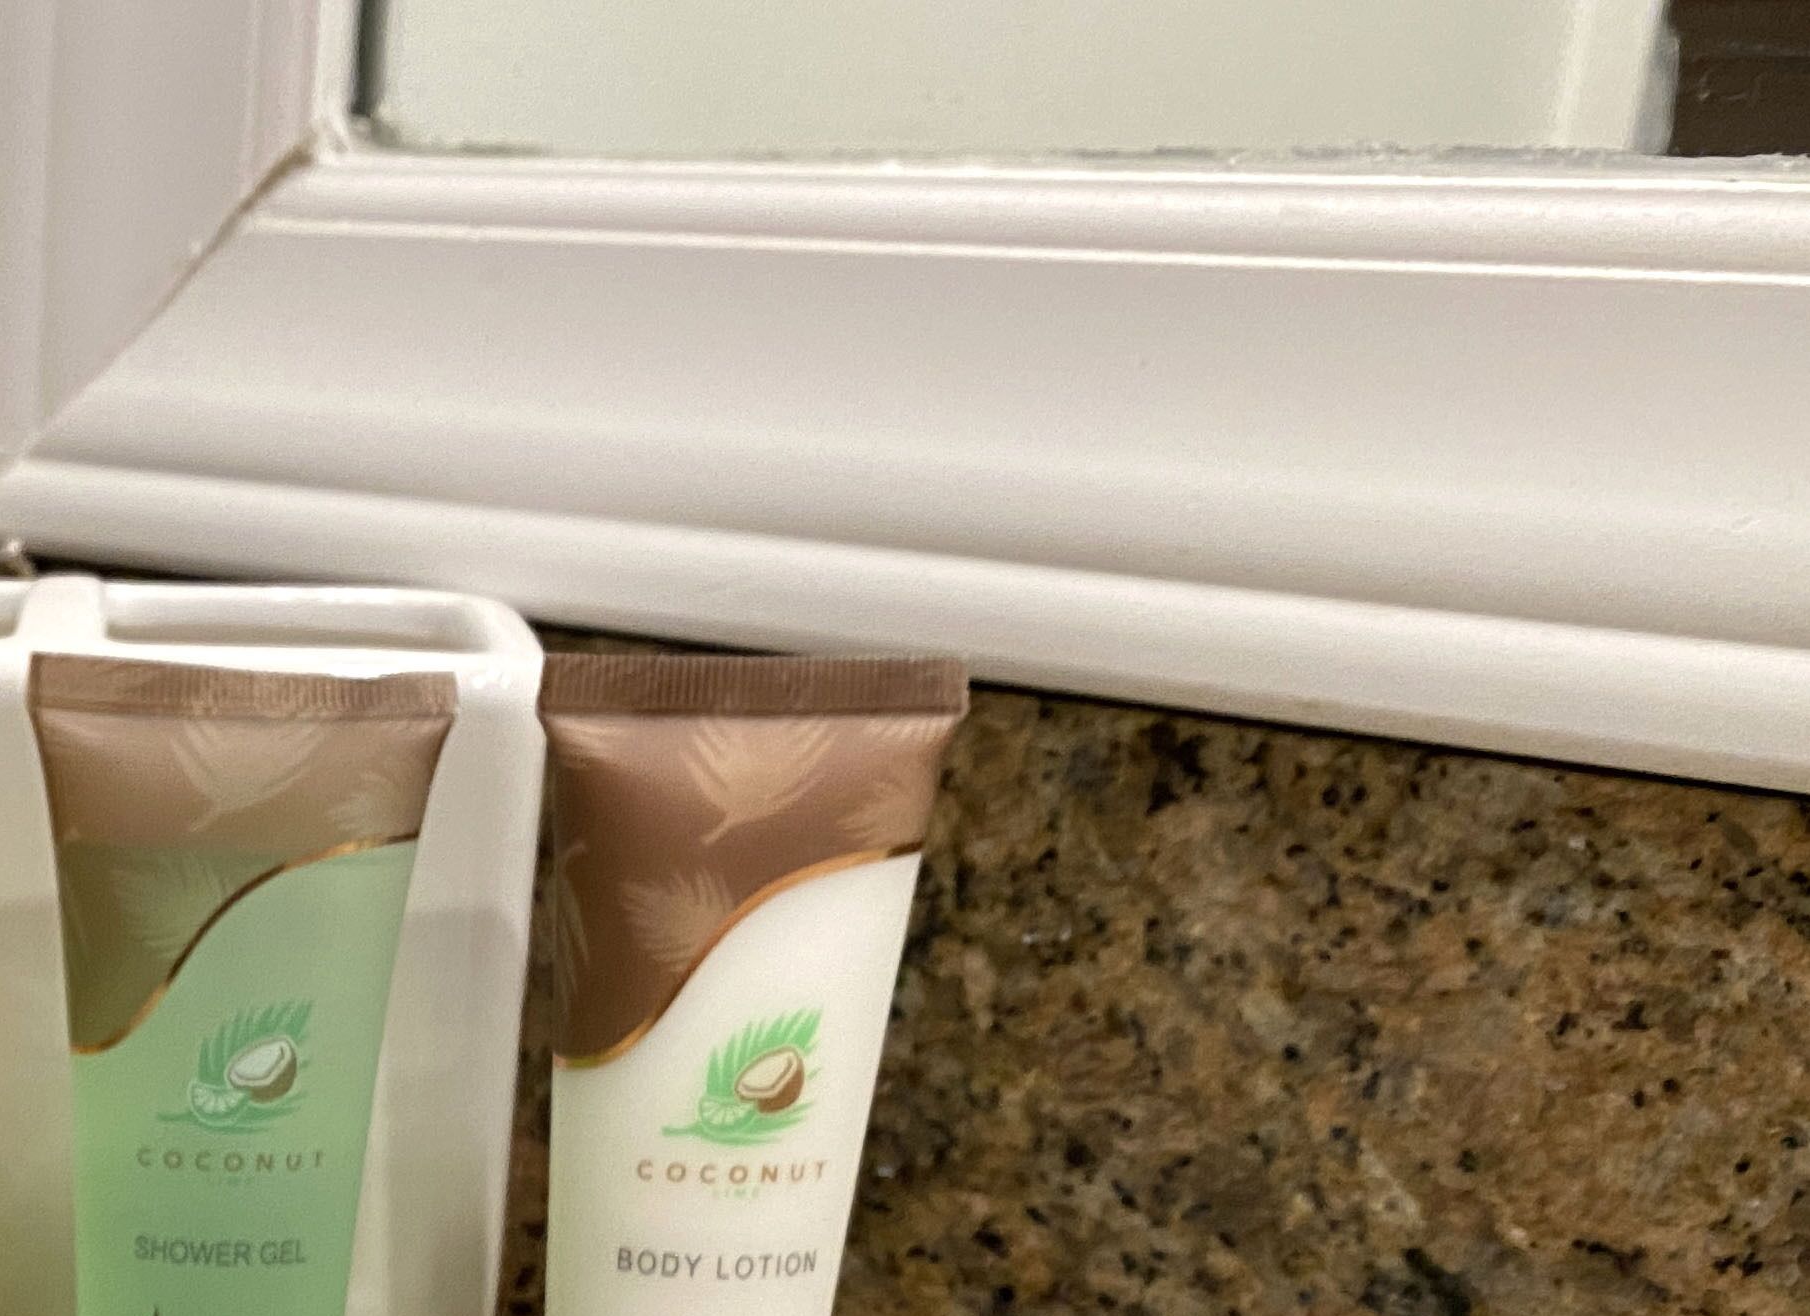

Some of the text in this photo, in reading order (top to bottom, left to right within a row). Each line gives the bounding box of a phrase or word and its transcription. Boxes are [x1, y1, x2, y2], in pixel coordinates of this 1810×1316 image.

[138, 1149, 324, 1173] COCONUT
[636, 1159, 828, 1184] COCONUT
[134, 1235, 307, 1267] SHOWER GEL
[616, 1247, 818, 1281] BODY LOTION
